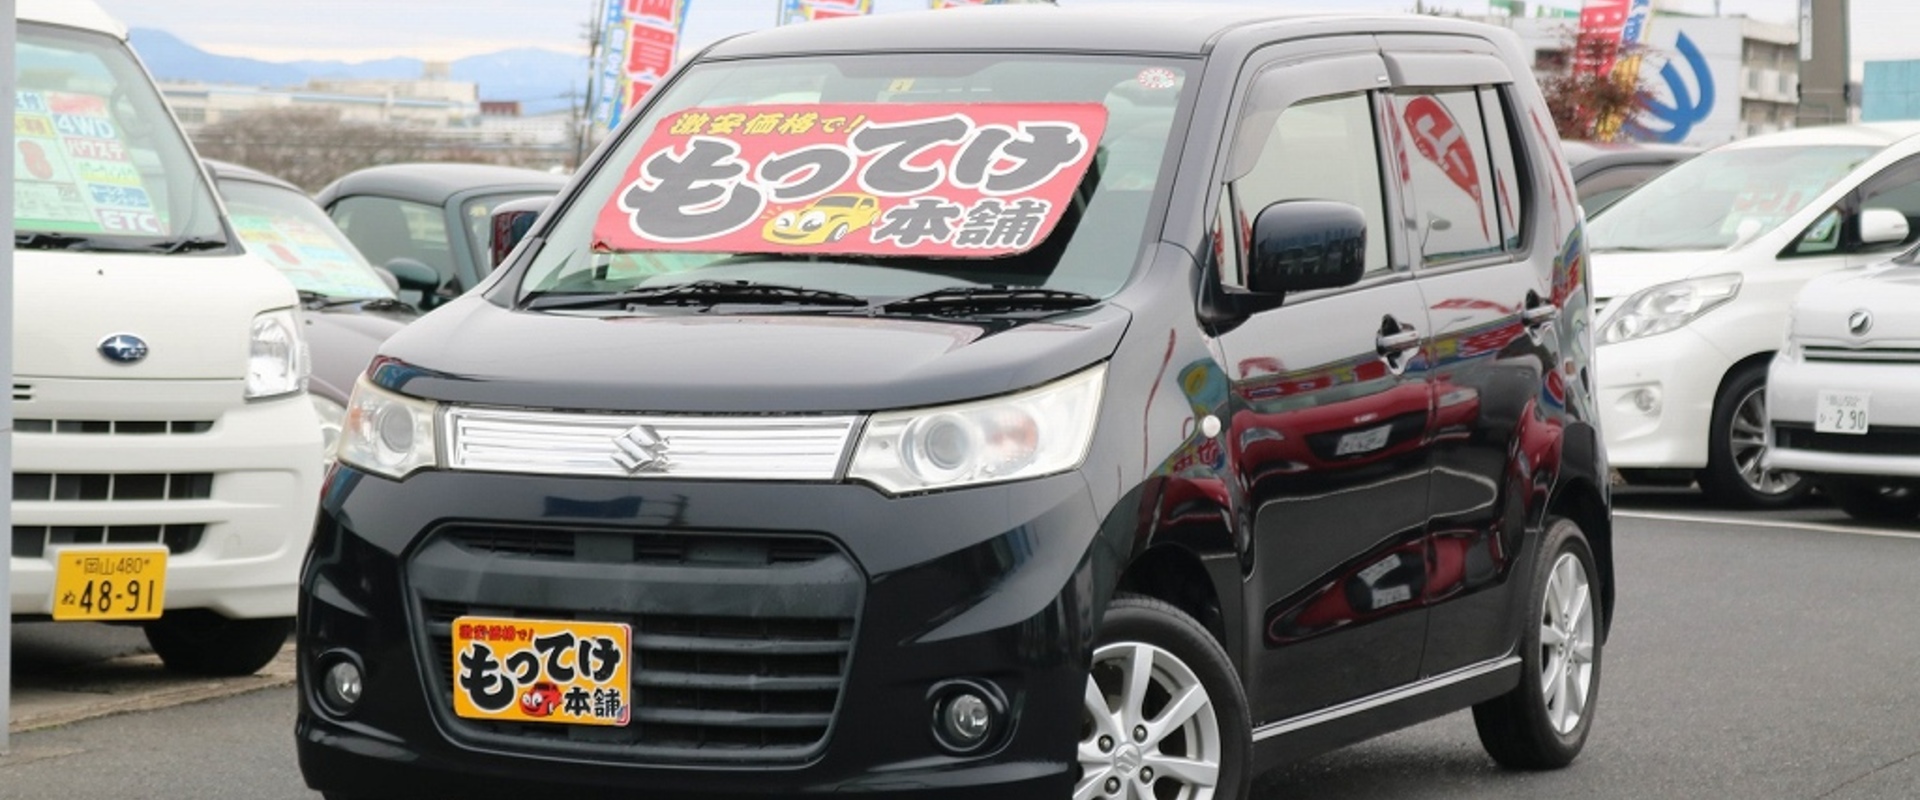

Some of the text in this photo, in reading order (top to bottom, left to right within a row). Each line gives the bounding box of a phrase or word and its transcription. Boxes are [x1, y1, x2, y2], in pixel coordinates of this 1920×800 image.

[59, 117, 112, 138] 4WD
[622, 117, 1085, 241] もってけ
[104, 211, 158, 232] ETC
[874, 200, 1046, 248] 本舗
[80, 579, 154, 614] 48-91
[460, 632, 620, 711] もってけ
[564, 686, 620, 718] 本舗
